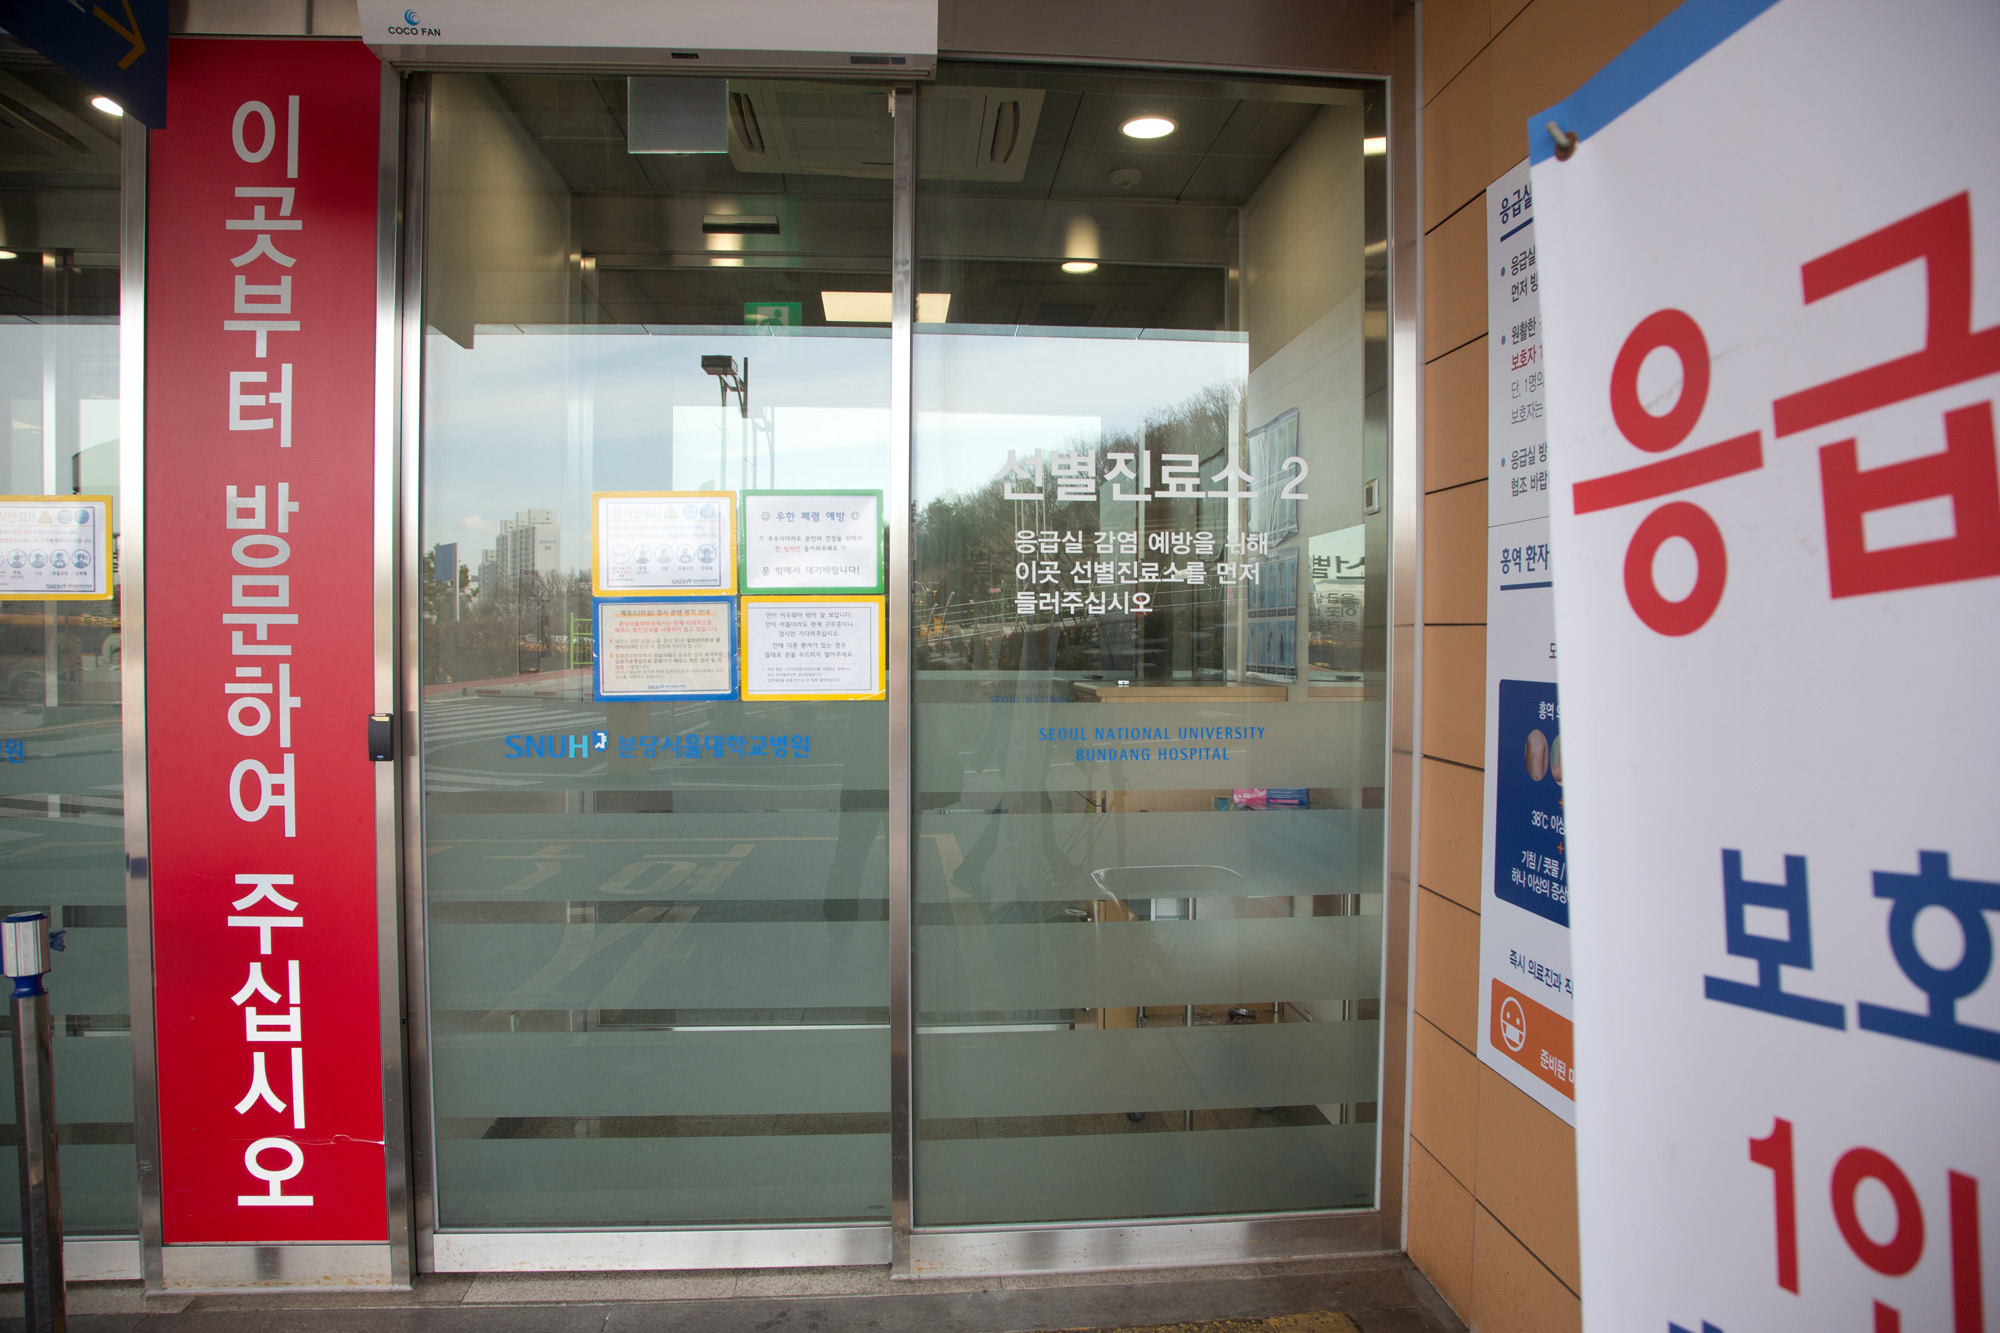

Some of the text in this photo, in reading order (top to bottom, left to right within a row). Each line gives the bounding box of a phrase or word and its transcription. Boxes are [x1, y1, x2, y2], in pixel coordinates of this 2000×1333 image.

[387, 26, 442, 37] COCO FAN
[1510, 244, 1536, 277] 응급실
[1511, 277, 1528, 303] 먼저
[1511, 316, 1537, 346] 원활한
[1511, 344, 1537, 372] 보호자
[1511, 379, 1521, 399] 단,
[1511, 400, 1544, 425] 보호자는
[1572, 188, 2000, 637] 응급
[1510, 444, 1536, 471] 응급실
[994, 448, 1309, 502] 선별진료소 2
[1511, 476, 1528, 498] 협조
[776, 511, 846, 523] 우한 폐렴 예방
[1014, 530, 1269, 555] 응급실 감염 예방을 위해
[762, 565, 860, 576] 문 밖에서 대기바랍니다!
[1500, 543, 1550, 574] 홍역 환자
[1015, 560, 1260, 585] 이곳 선별진료소를 먼저
[1014, 591, 1153, 616] 들러주십시오
[222, 95, 314, 1207] 이곳부터 방문하여 주십시오
[1539, 701, 1555, 721] 홍역
[504, 734, 810, 759] SNUH 분당서울대학교병원
[1038, 726, 1266, 741] SEOUL NATIONAL UNIVERSITY
[1076, 747, 1230, 762] BUNDANG HOSPITAL
[1521, 850, 1537, 870] 기침
[1543, 856, 1560, 879] 콧물
[1511, 867, 1526, 888] 하나
[1527, 873, 1550, 898] 이상의
[1703, 847, 2000, 1065] 보호
[1509, 949, 1525, 974] 즉시
[1528, 960, 1562, 993] 의료진과
[1540, 1048, 1567, 1082] 준비된
